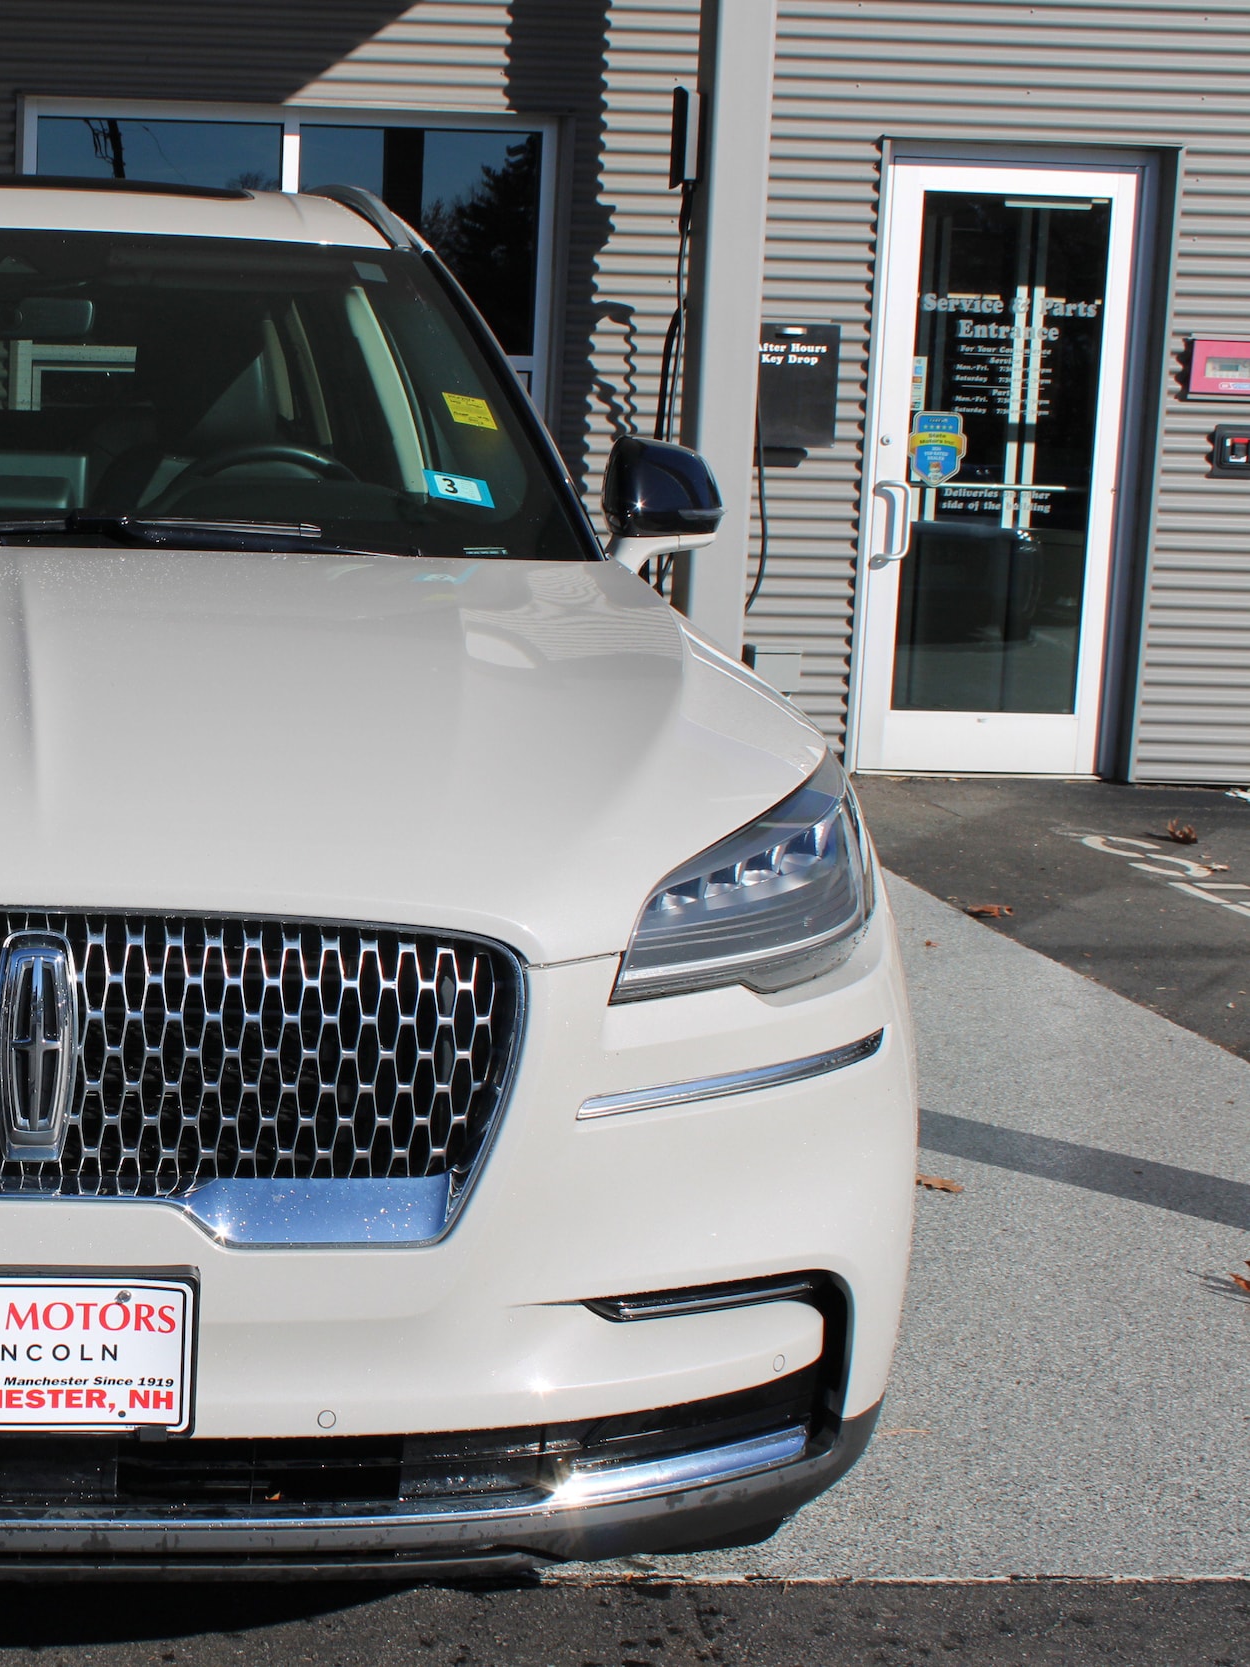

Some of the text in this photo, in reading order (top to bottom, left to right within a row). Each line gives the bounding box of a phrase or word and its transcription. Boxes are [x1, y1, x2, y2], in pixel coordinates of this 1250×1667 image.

[922, 293, 1097, 318] Service & Parts
[957, 319, 1060, 341] Entrance
[758, 343, 827, 353] After Hours
[977, 345, 996, 353] Your
[761, 354, 818, 365] Key Drop
[953, 375, 988, 383] Saturday
[954, 406, 987, 414] Saturday
[442, 478, 459, 494] 3
[944, 488, 999, 498] Deliveries
[942, 500, 1051, 513] side of the building
[5, 1301, 176, 1334] MOTORS
[3, 1376, 88, 1387] Manchester
[93, 1376, 133, 1387] Since
[138, 1377, 174, 1387] 1919
[128, 1390, 173, 1410] NH
